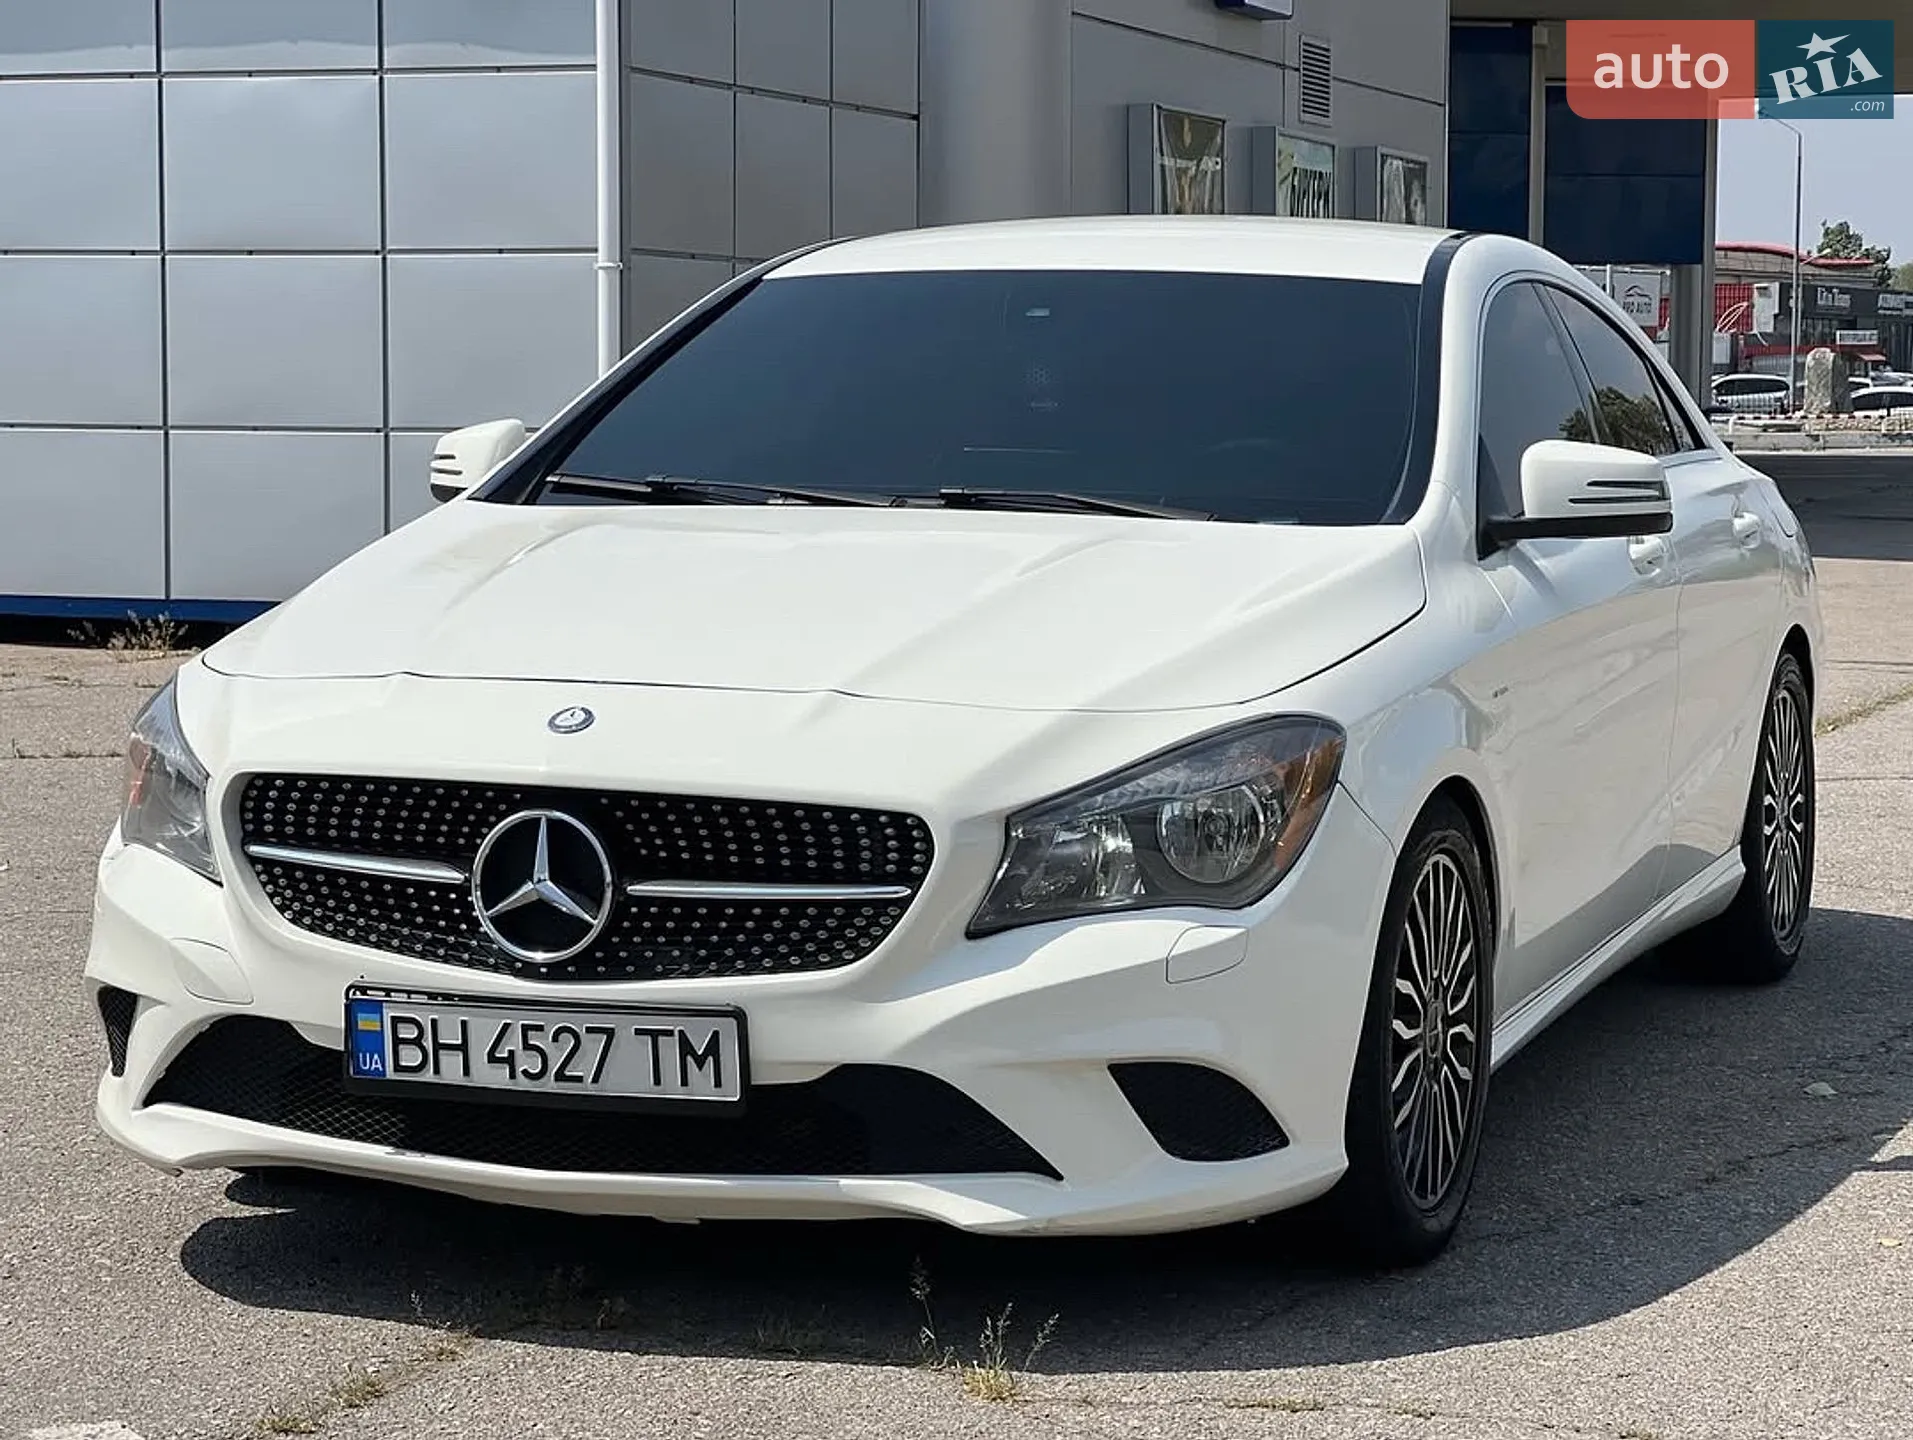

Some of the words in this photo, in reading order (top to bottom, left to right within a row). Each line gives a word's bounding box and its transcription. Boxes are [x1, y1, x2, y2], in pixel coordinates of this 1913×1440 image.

[358, 1052, 383, 1072] UA
[389, 1014, 470, 1077] BH
[486, 1021, 616, 1083] 4527
[633, 1025, 723, 1088] TM
